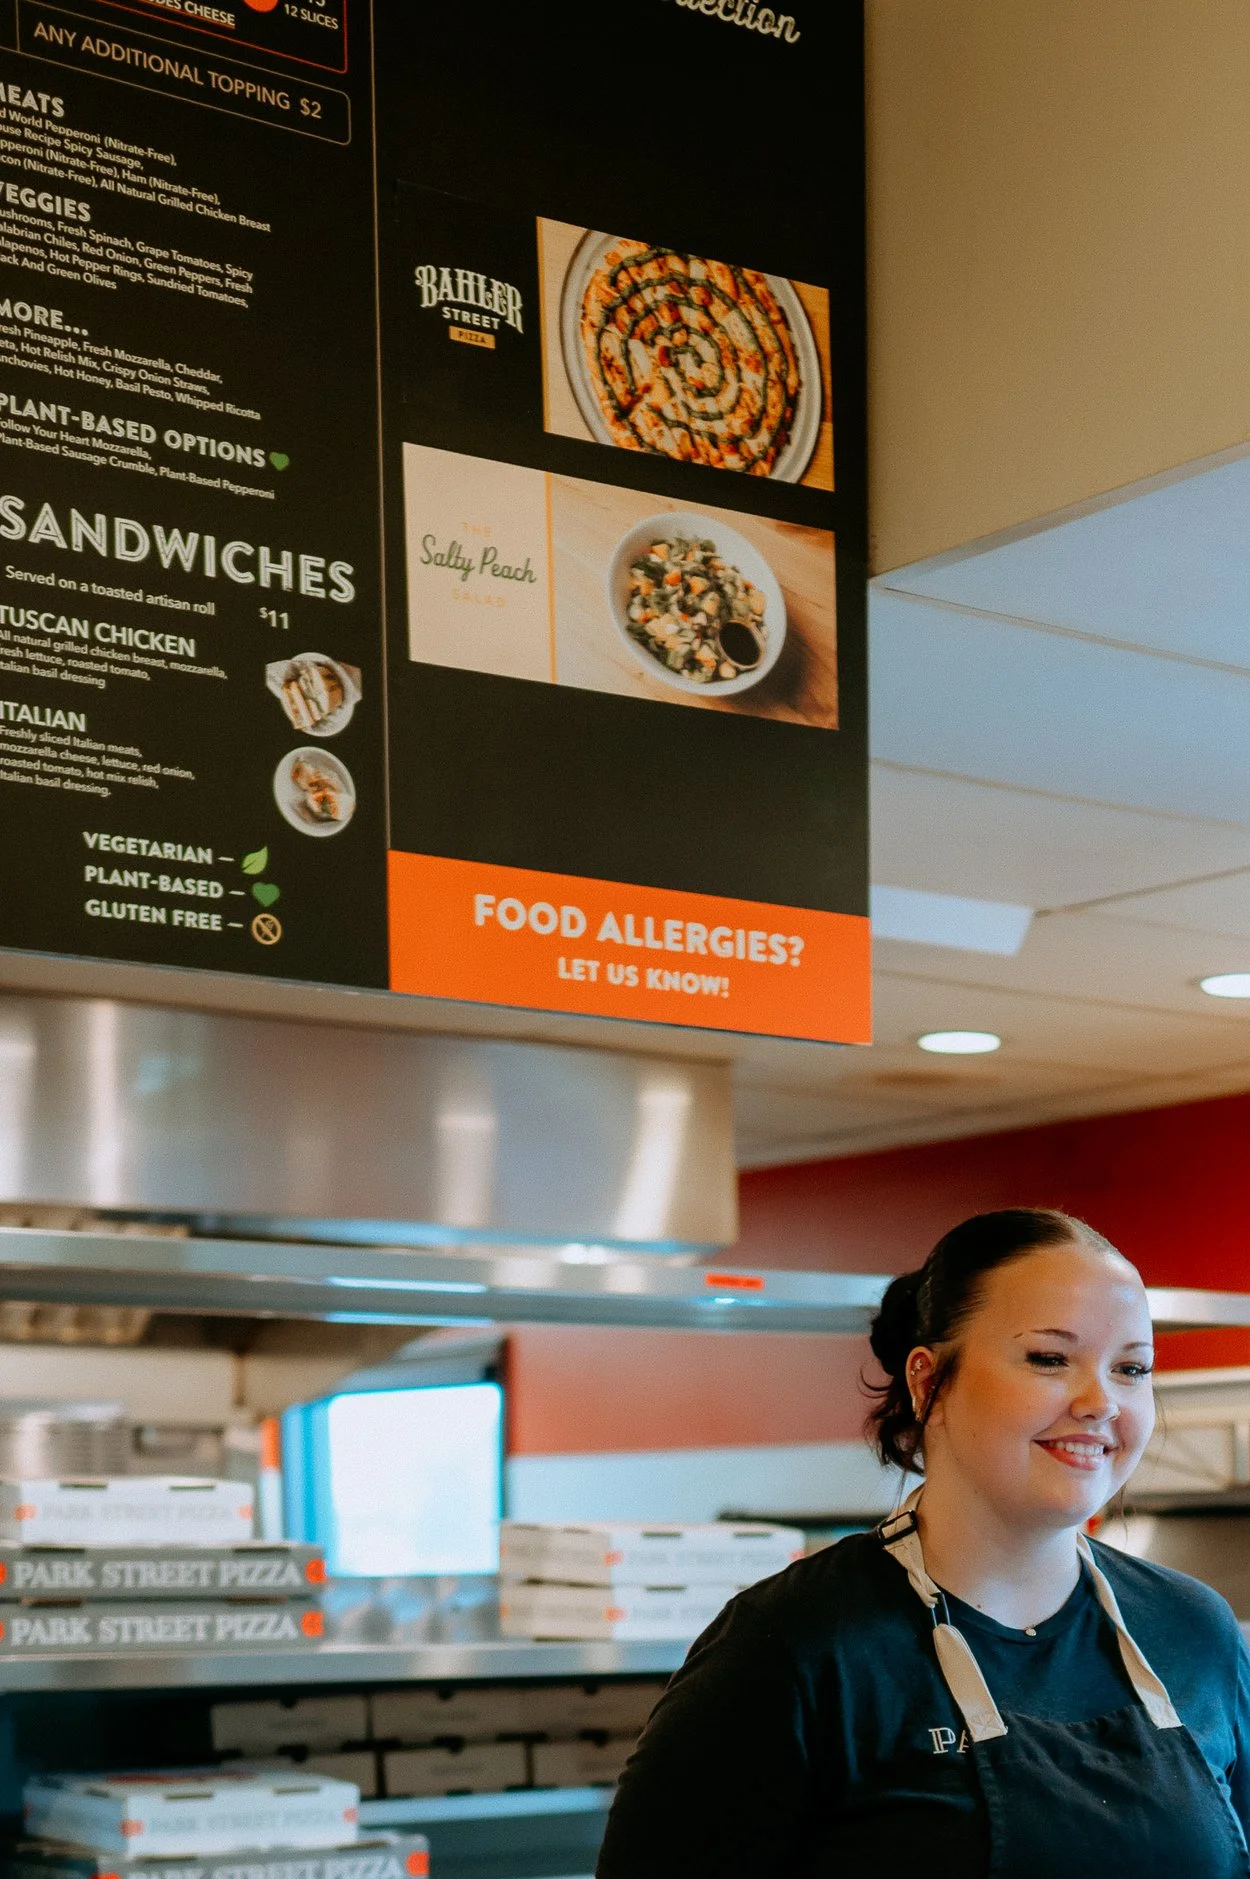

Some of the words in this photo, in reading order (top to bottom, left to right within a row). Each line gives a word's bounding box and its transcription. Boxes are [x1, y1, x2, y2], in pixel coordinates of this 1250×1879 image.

[184, 1, 236, 27] CHEESE
[285, 4, 298, 18] 12
[300, 8, 339, 30] SLICES
[675, 0, 801, 43] ection
[34, 21, 77, 48] ANY
[81, 36, 204, 86] ADDITIONAL
[208, 70, 291, 110] TOPPING
[300, 97, 322, 119] $2
[9, 109, 43, 129] World
[45, 120, 101, 144] Pepperoni
[104, 136, 177, 166] (Nitrate-Free),
[24, 127, 61, 147] Recipe
[63, 138, 93, 158] Spicy
[96, 147, 144, 170] Sausage,
[0, 140, 44, 158] pperoni
[45, 149, 120, 179] (Nitrate-Free),
[122, 169, 147, 184] Ham
[149, 176, 220, 205] (Nitrate-Free),
[0, 154, 21, 167] con
[23, 158, 98, 188] (Nitrate-Free),
[100, 178, 115, 191] All
[117, 182, 155, 202] Natural
[158, 193, 194, 212] Grilled
[195, 203, 237, 223] Chicken
[239, 214, 271, 232] Breast
[0, 208, 56, 231] ushrooms,
[57, 221, 87, 238] Fresh
[89, 229, 134, 251] Spinach,
[136, 241, 169, 259] Grape
[171, 249, 224, 273] Tomatoes,
[225, 263, 254, 282] Spicy
[43, 232, 80, 252] Chiles,
[82, 242, 104, 257] Red
[106, 248, 142, 267] Onion,
[144, 258, 176, 274] Green
[178, 265, 223, 288] Peppers,
[225, 277, 253, 294] Fresh
[0, 254, 19, 266] ack
[21, 257, 45, 272] And
[47, 263, 80, 280] Green
[82, 272, 117, 289] Olives
[50, 249, 70, 263] Hot
[72, 254, 111, 272] Pepper
[113, 264, 145, 283] Rings,
[147, 272, 195, 294] Sundried
[196, 284, 249, 309] Tomatoes,
[414, 264, 524, 334] BAHLER
[441, 306, 500, 330] STREET
[0, 324, 21, 337] resh
[24, 327, 81, 352] Pineapple,
[83, 341, 112, 357] Fresh
[114, 348, 173, 373] Mozzarella,
[175, 362, 223, 384] Cheddar,
[0, 339, 19, 352] eta,
[21, 342, 41, 357] Hot
[43, 346, 75, 363] Relish
[78, 355, 101, 371] Mix,
[102, 360, 137, 379] Crispy
[138, 369, 171, 386] Onion
[173, 376, 211, 396] Straws,
[0, 354, 52, 375] nchovies,
[54, 364, 74, 379] Hot
[76, 369, 114, 389] Honey,
[115, 378, 140, 393] Basil
[142, 383, 174, 402] Pesto,
[175, 391, 224, 412] Whipped
[225, 402, 261, 420] Ricotta
[0, 392, 157, 444] PLANT-BASED
[164, 429, 266, 468] OPTIONS
[0, 419, 31, 434] ollow
[32, 424, 58, 440] Your
[60, 430, 90, 446] Heart
[92, 437, 152, 460] Mozzarella,
[61, 445, 107, 466] Sausage
[109, 456, 158, 476] Crumble,
[159, 466, 221, 488] Plant-Based
[222, 479, 275, 500] Pepperoni
[0, 495, 356, 603] SANDWICHES
[420, 534, 475, 582] Salty
[479, 546, 537, 583] Peach
[5, 565, 55, 587] Served
[58, 576, 77, 590] on
[80, 582, 89, 592] a
[91, 582, 143, 602] toasted
[146, 593, 191, 611] artisan
[193, 601, 216, 616] roll
[0, 604, 89, 639] TUSCAN
[94, 622, 195, 658] CHICKEN
[259, 606, 289, 630] $11
[0, 646, 23, 658] resh
[25, 648, 66, 666] lettuce,
[68, 659, 108, 672] roasted
[109, 664, 151, 681] tomato,
[13, 634, 51, 648] natural
[53, 641, 88, 655] grilled
[90, 646, 130, 661] chicken
[132, 652, 168, 669] breast,
[0, 660, 30, 674] talian
[32, 664, 58, 679] basil
[60, 669, 106, 689] dressing
[0, 701, 87, 732] ITALIAN
[39, 731, 71, 746] sliced
[35, 773, 61, 789] basil
[86, 766, 105, 780] hot
[142, 763, 161, 774] red
[82, 831, 213, 865] VEGETARIAN
[84, 864, 224, 899] PLANT-BASED
[85, 899, 166, 924] GLUTEN
[172, 909, 223, 932] FREE
[473, 894, 587, 939] FOOD
[596, 911, 806, 968] ALLERGIES?
[557, 956, 599, 982] LET
[606, 963, 639, 988] US
[646, 968, 730, 998] KNOW!
[12, 1560, 95, 1588] PARK
[101, 1559, 213, 1588] STREET
[219, 1559, 302, 1588] PIZZA
[10, 1616, 92, 1646] PARK
[99, 1615, 210, 1644] STREET
[215, 1613, 299, 1641] PIZZA
